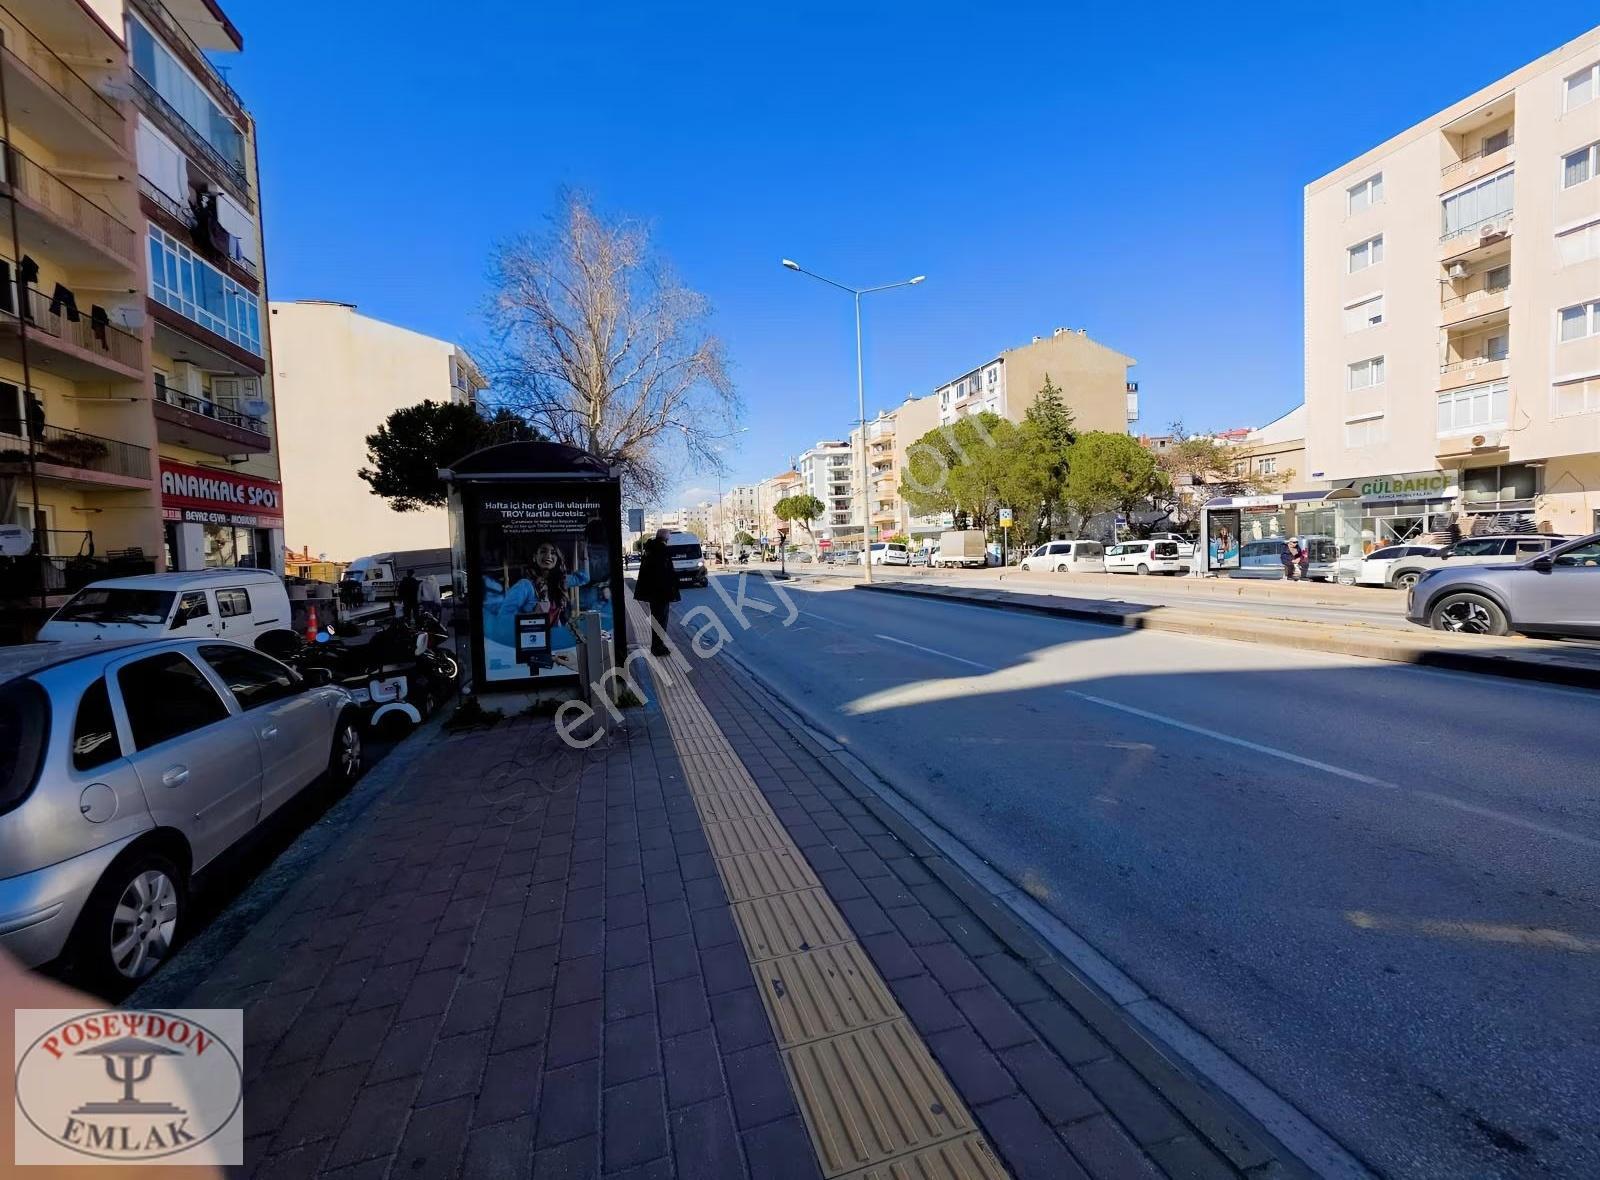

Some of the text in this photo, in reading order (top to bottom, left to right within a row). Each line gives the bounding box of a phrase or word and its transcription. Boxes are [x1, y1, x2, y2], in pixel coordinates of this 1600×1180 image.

[160, 471, 280, 508] ANAKKALE SPOT
[537, 502, 553, 511] gün
[185, 510, 209, 522] BEYAZ
[501, 510, 524, 518] TROY
[525, 510, 551, 518] kartla
